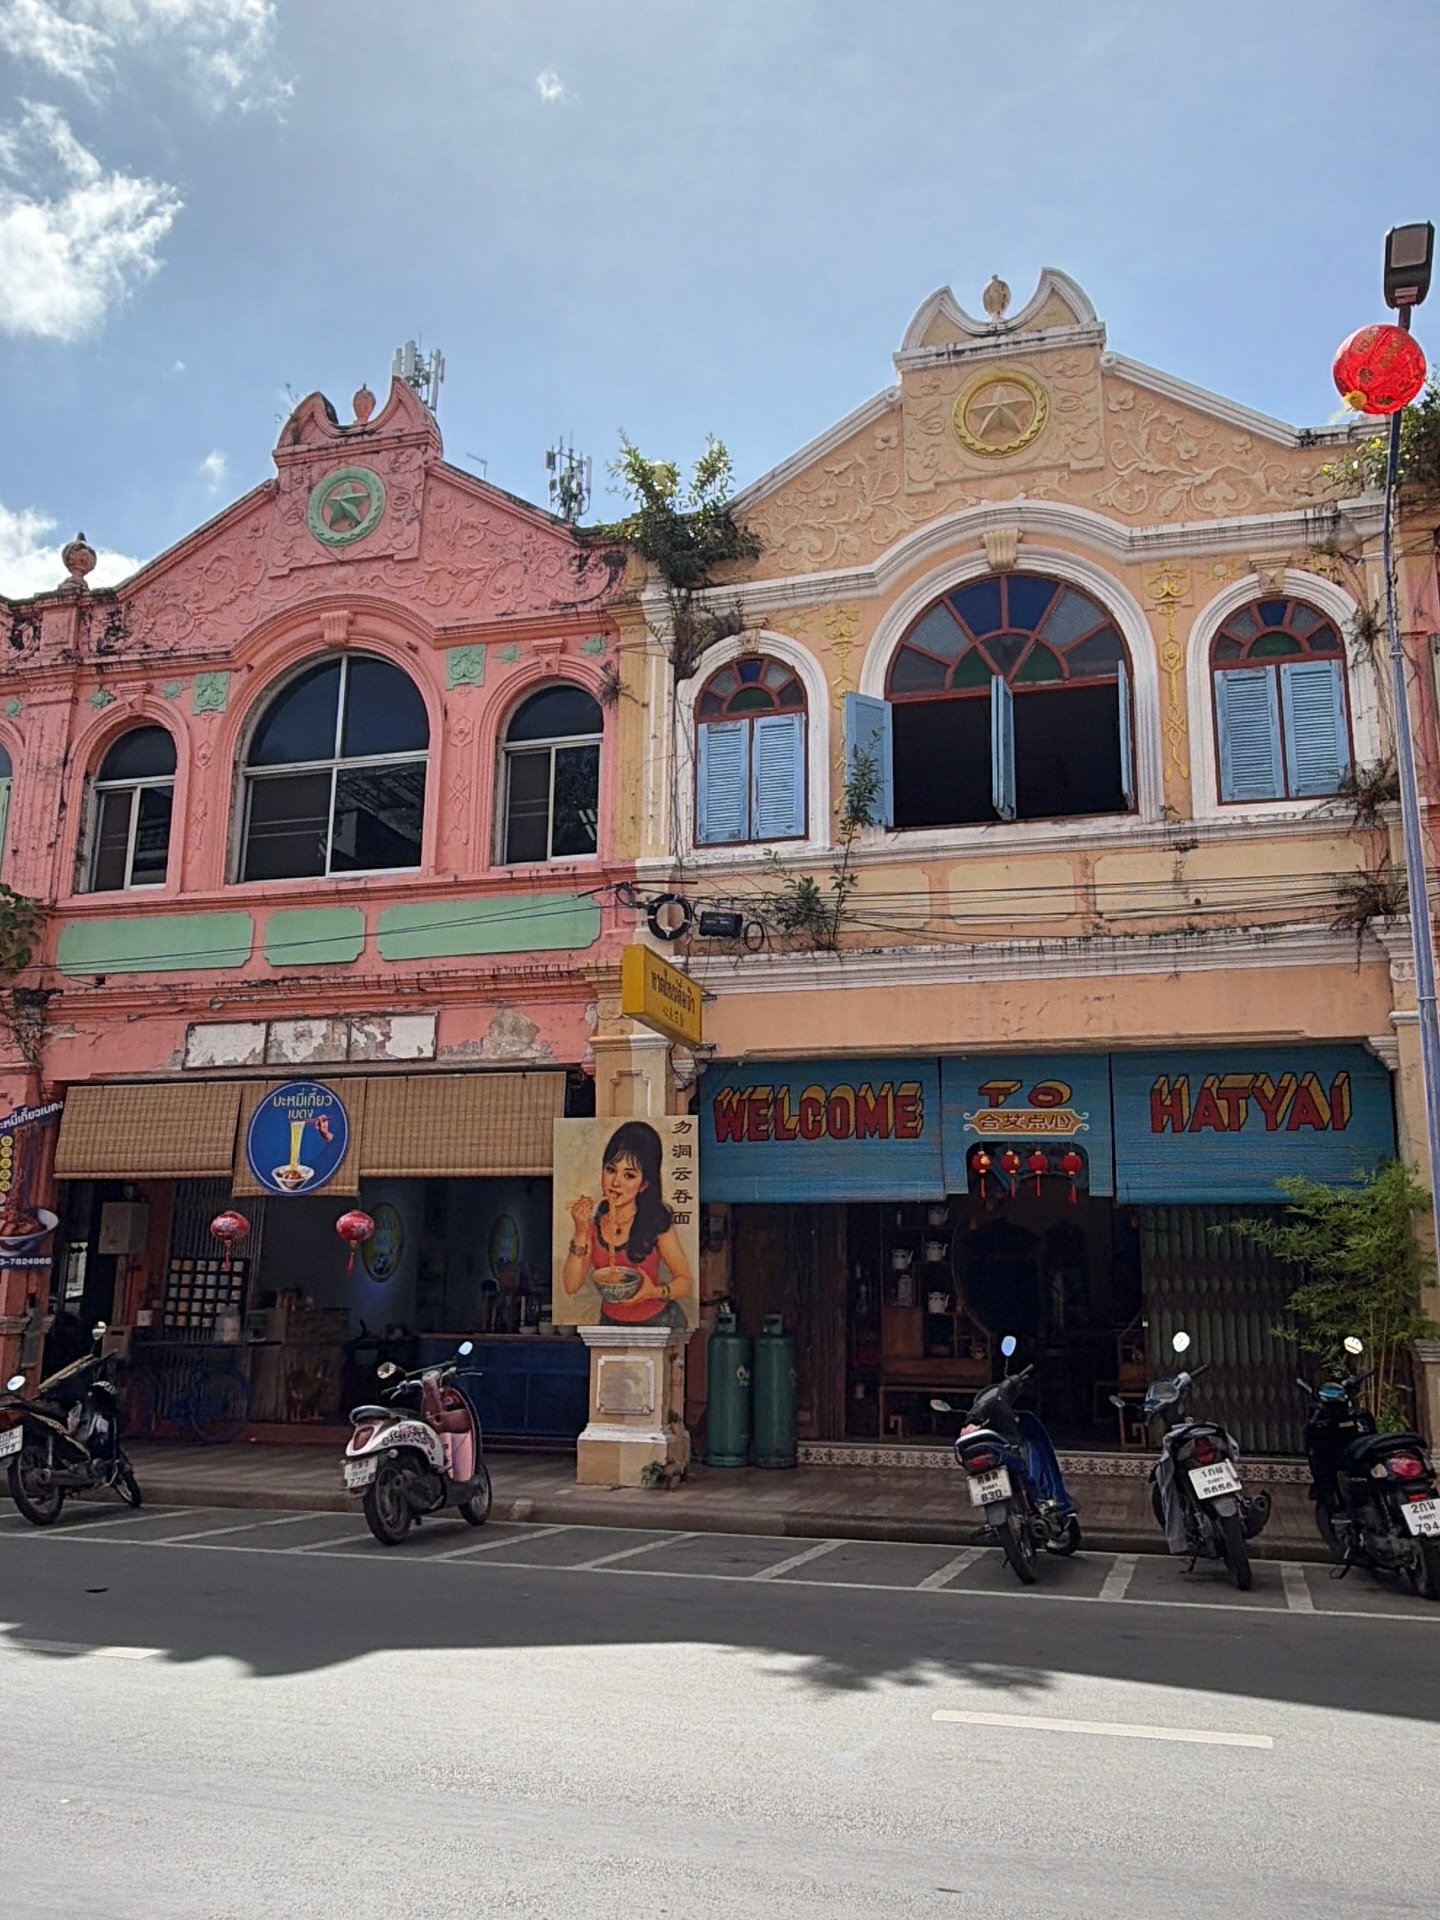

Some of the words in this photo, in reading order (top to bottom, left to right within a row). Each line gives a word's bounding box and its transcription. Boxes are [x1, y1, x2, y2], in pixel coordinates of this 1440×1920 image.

[273, 1087, 333, 1107] บะหมี่เกี๊ยว
[713, 1081, 924, 1143] WELCOME
[978, 1079, 1073, 1109] TO
[1151, 1071, 1352, 1133] HATYAI
[288, 1108, 314, 1119] เบตง
[979, 1114, 1073, 1130] 合艾点心
[671, 1120, 693, 1225] 勿洞云吞面
